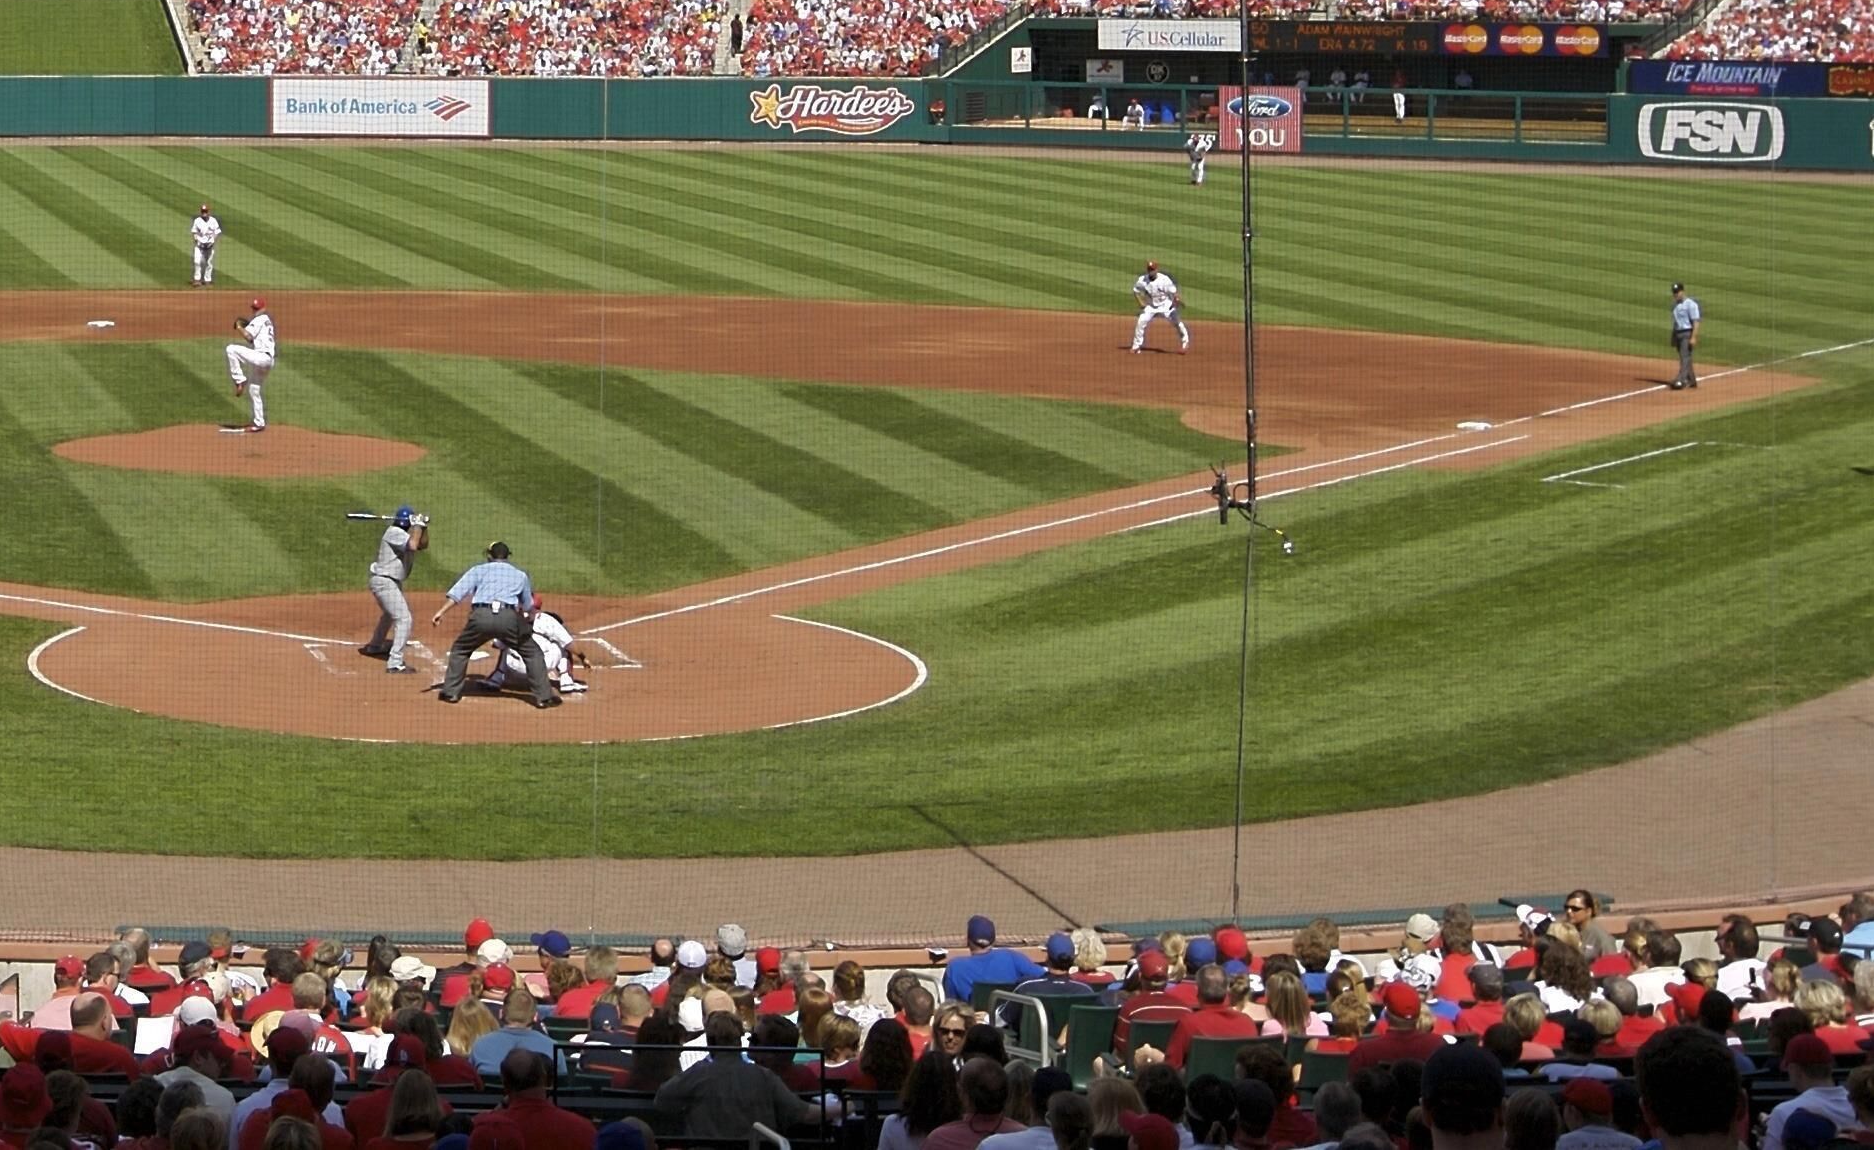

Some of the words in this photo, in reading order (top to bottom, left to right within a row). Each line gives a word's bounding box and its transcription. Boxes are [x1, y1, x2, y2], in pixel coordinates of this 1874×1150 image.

[1666, 62, 1695, 82] ICE
[1695, 63, 1782, 84] MOUNTAIN
[286, 98, 327, 114] Bank
[330, 98, 348, 114] of
[349, 99, 417, 114] America
[777, 89, 910, 118] Hardee's
[1239, 97, 1280, 117] Ford
[1660, 110, 1761, 153] FSN
